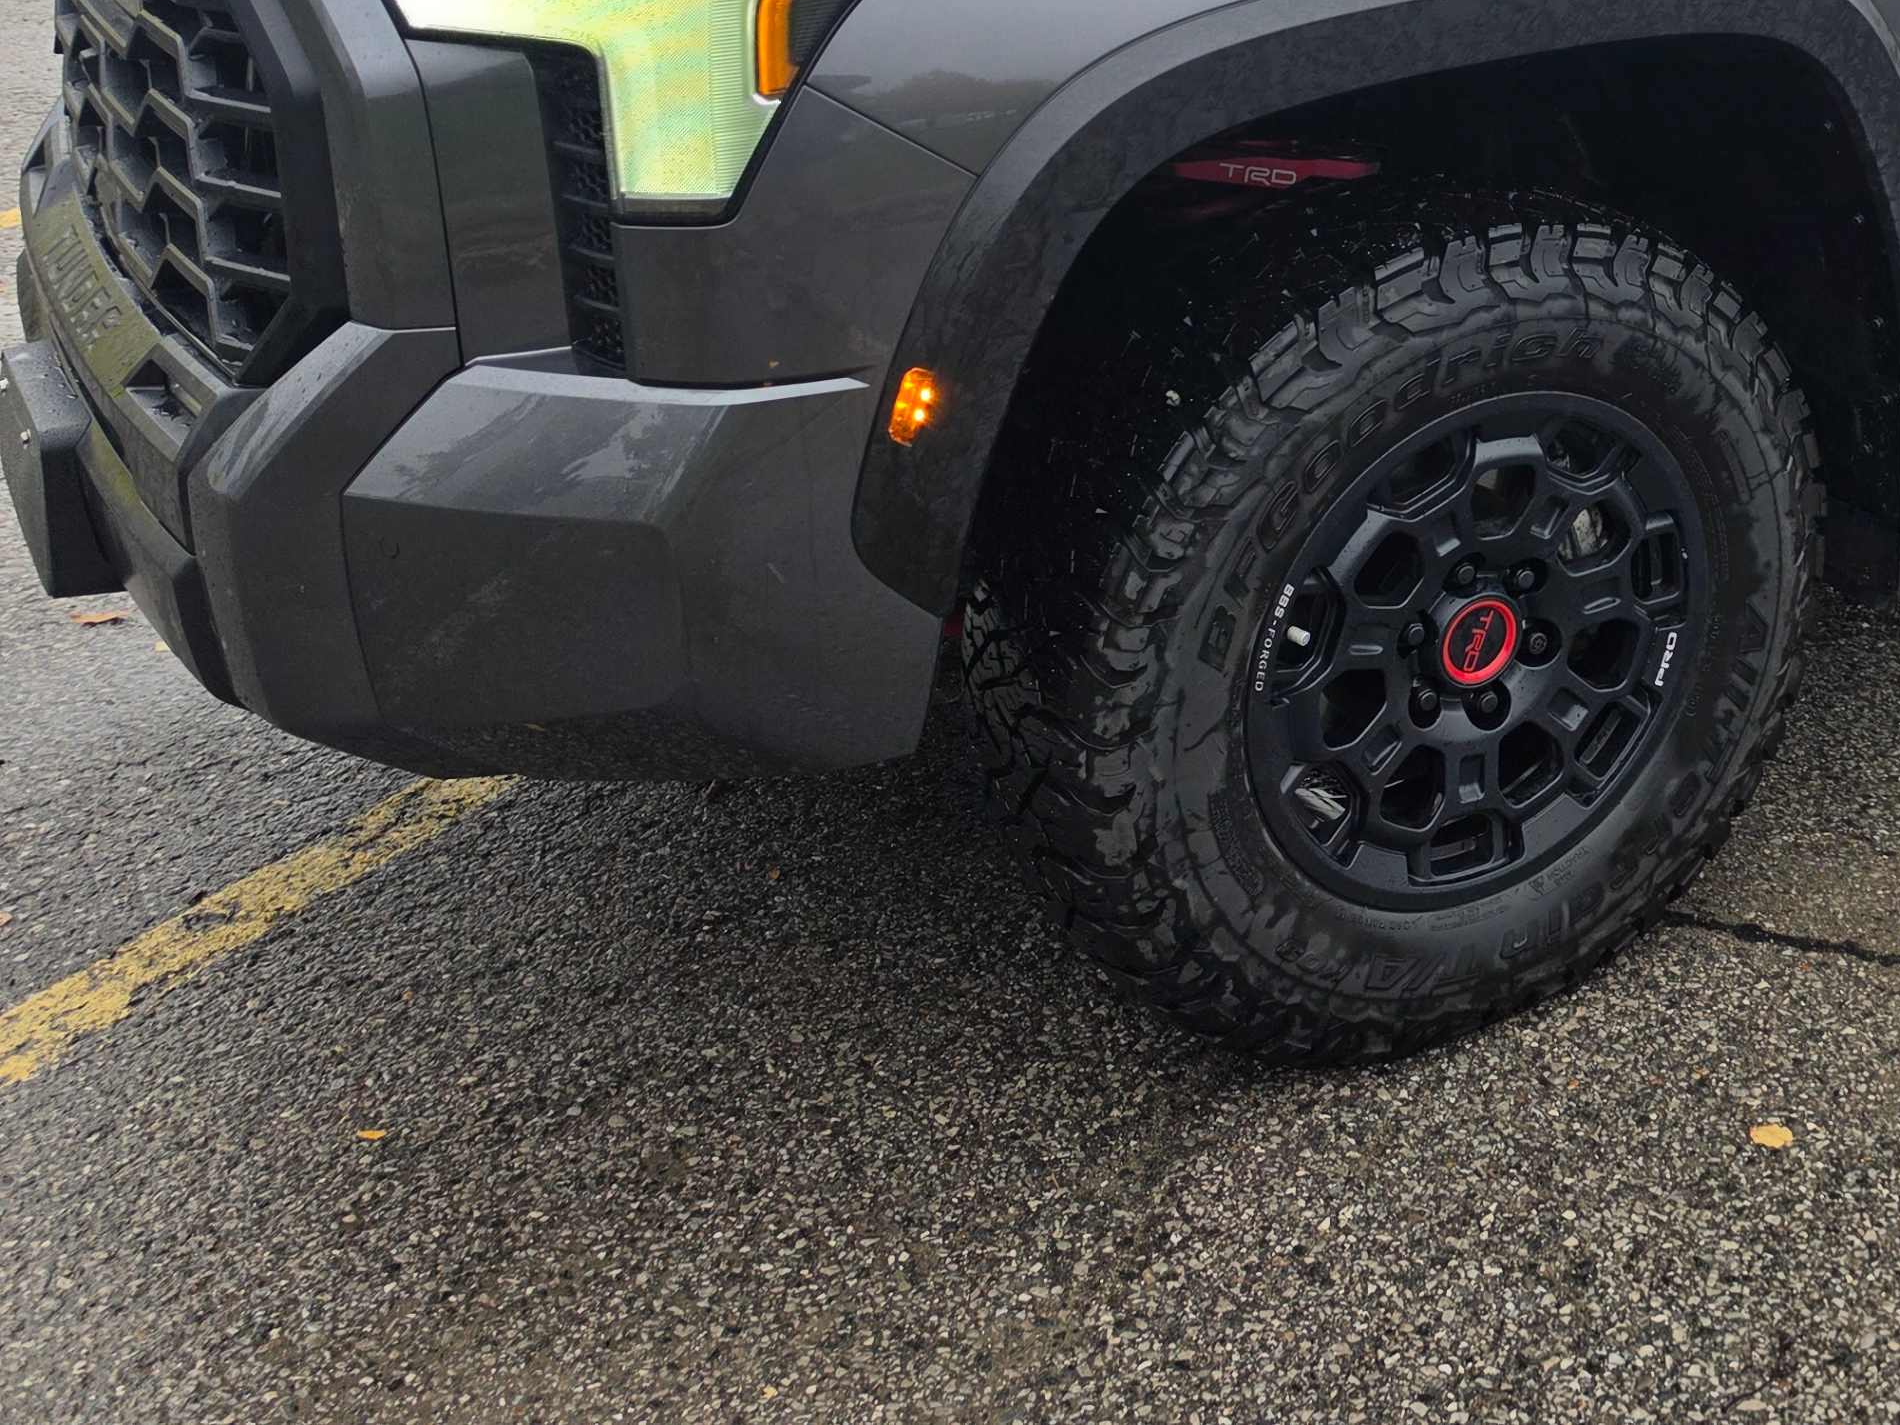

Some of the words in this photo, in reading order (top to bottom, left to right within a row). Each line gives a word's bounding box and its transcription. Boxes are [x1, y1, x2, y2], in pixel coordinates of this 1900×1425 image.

[1218, 162, 1297, 186] TRD
[1198, 325, 1602, 670] BFGoodrich
[1463, 609, 1494, 672] TRD
[1654, 631, 1677, 687] PRO
